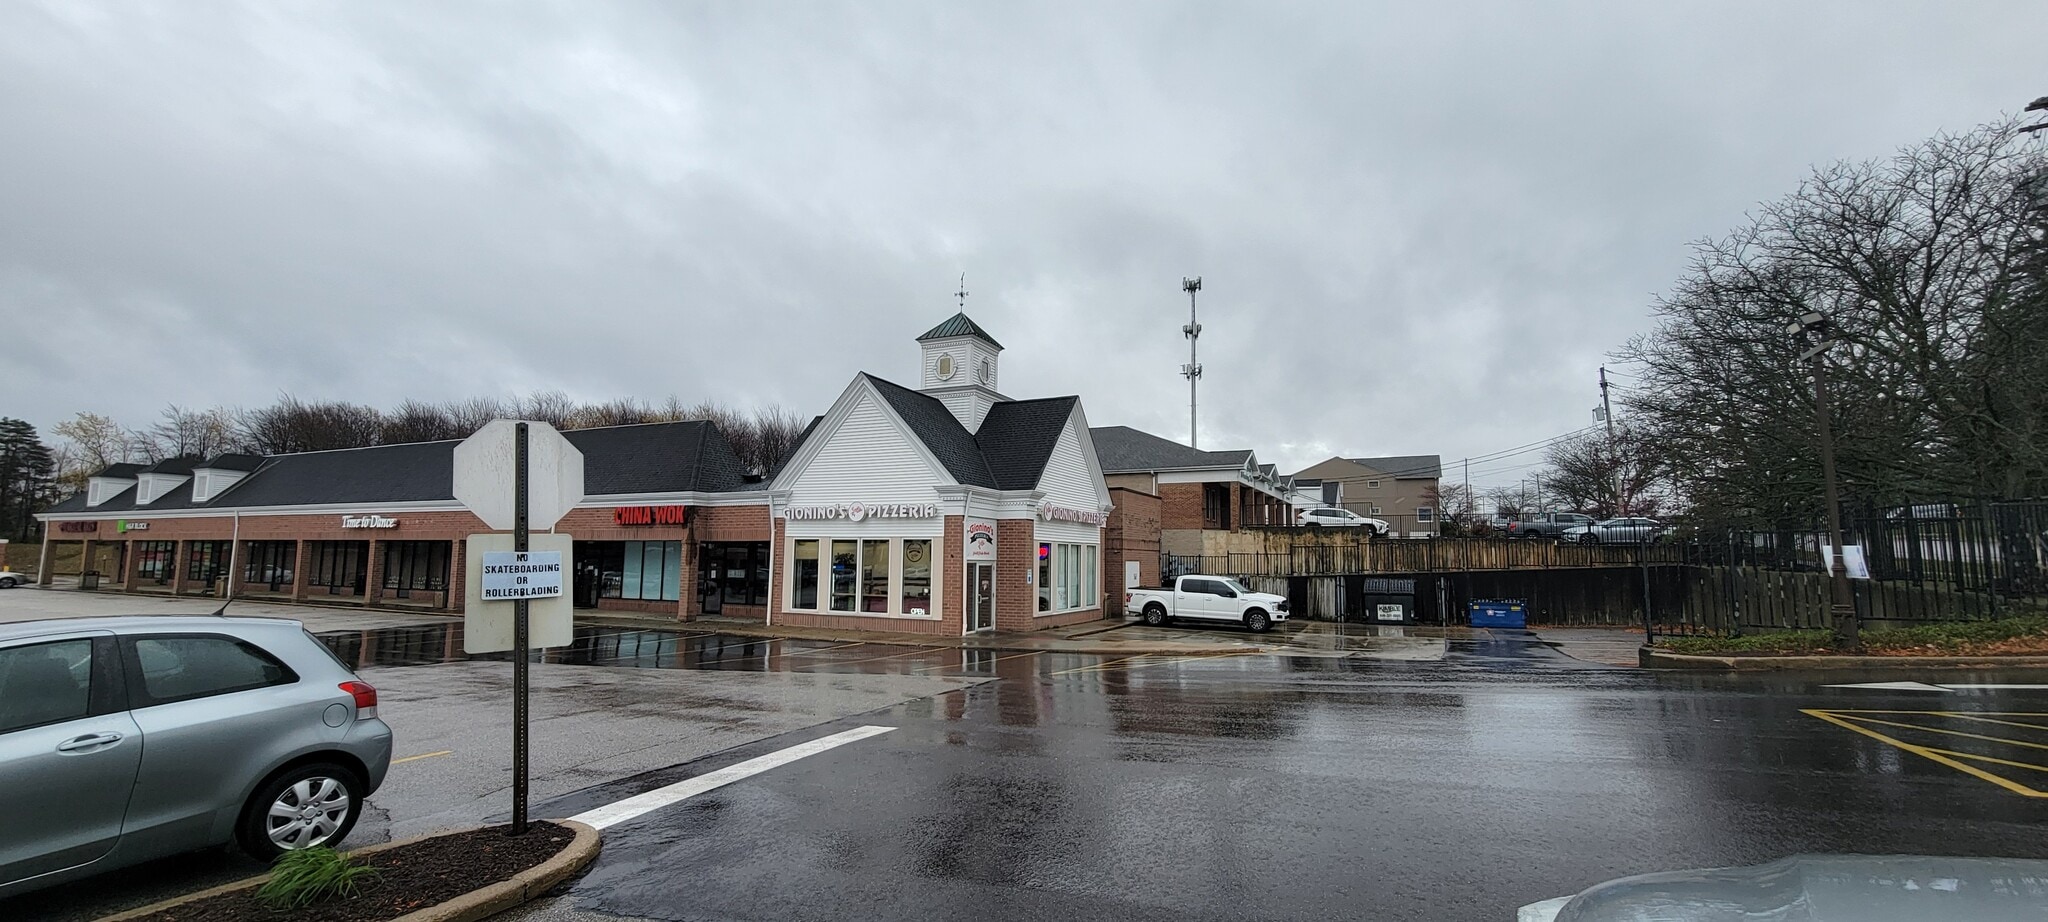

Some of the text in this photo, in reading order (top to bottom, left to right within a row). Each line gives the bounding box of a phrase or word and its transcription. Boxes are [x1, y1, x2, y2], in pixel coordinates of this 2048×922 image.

[615, 504, 685, 524] CHINA WOK
[783, 504, 847, 520] GIONINO'S
[868, 504, 934, 518] PIZZERIA
[370, 515, 397, 528] Dance
[517, 553, 529, 562] NO
[484, 564, 560, 574] SKATEBOARDING
[516, 576, 528, 585] OR
[485, 586, 559, 598] ROLLERBLADING
